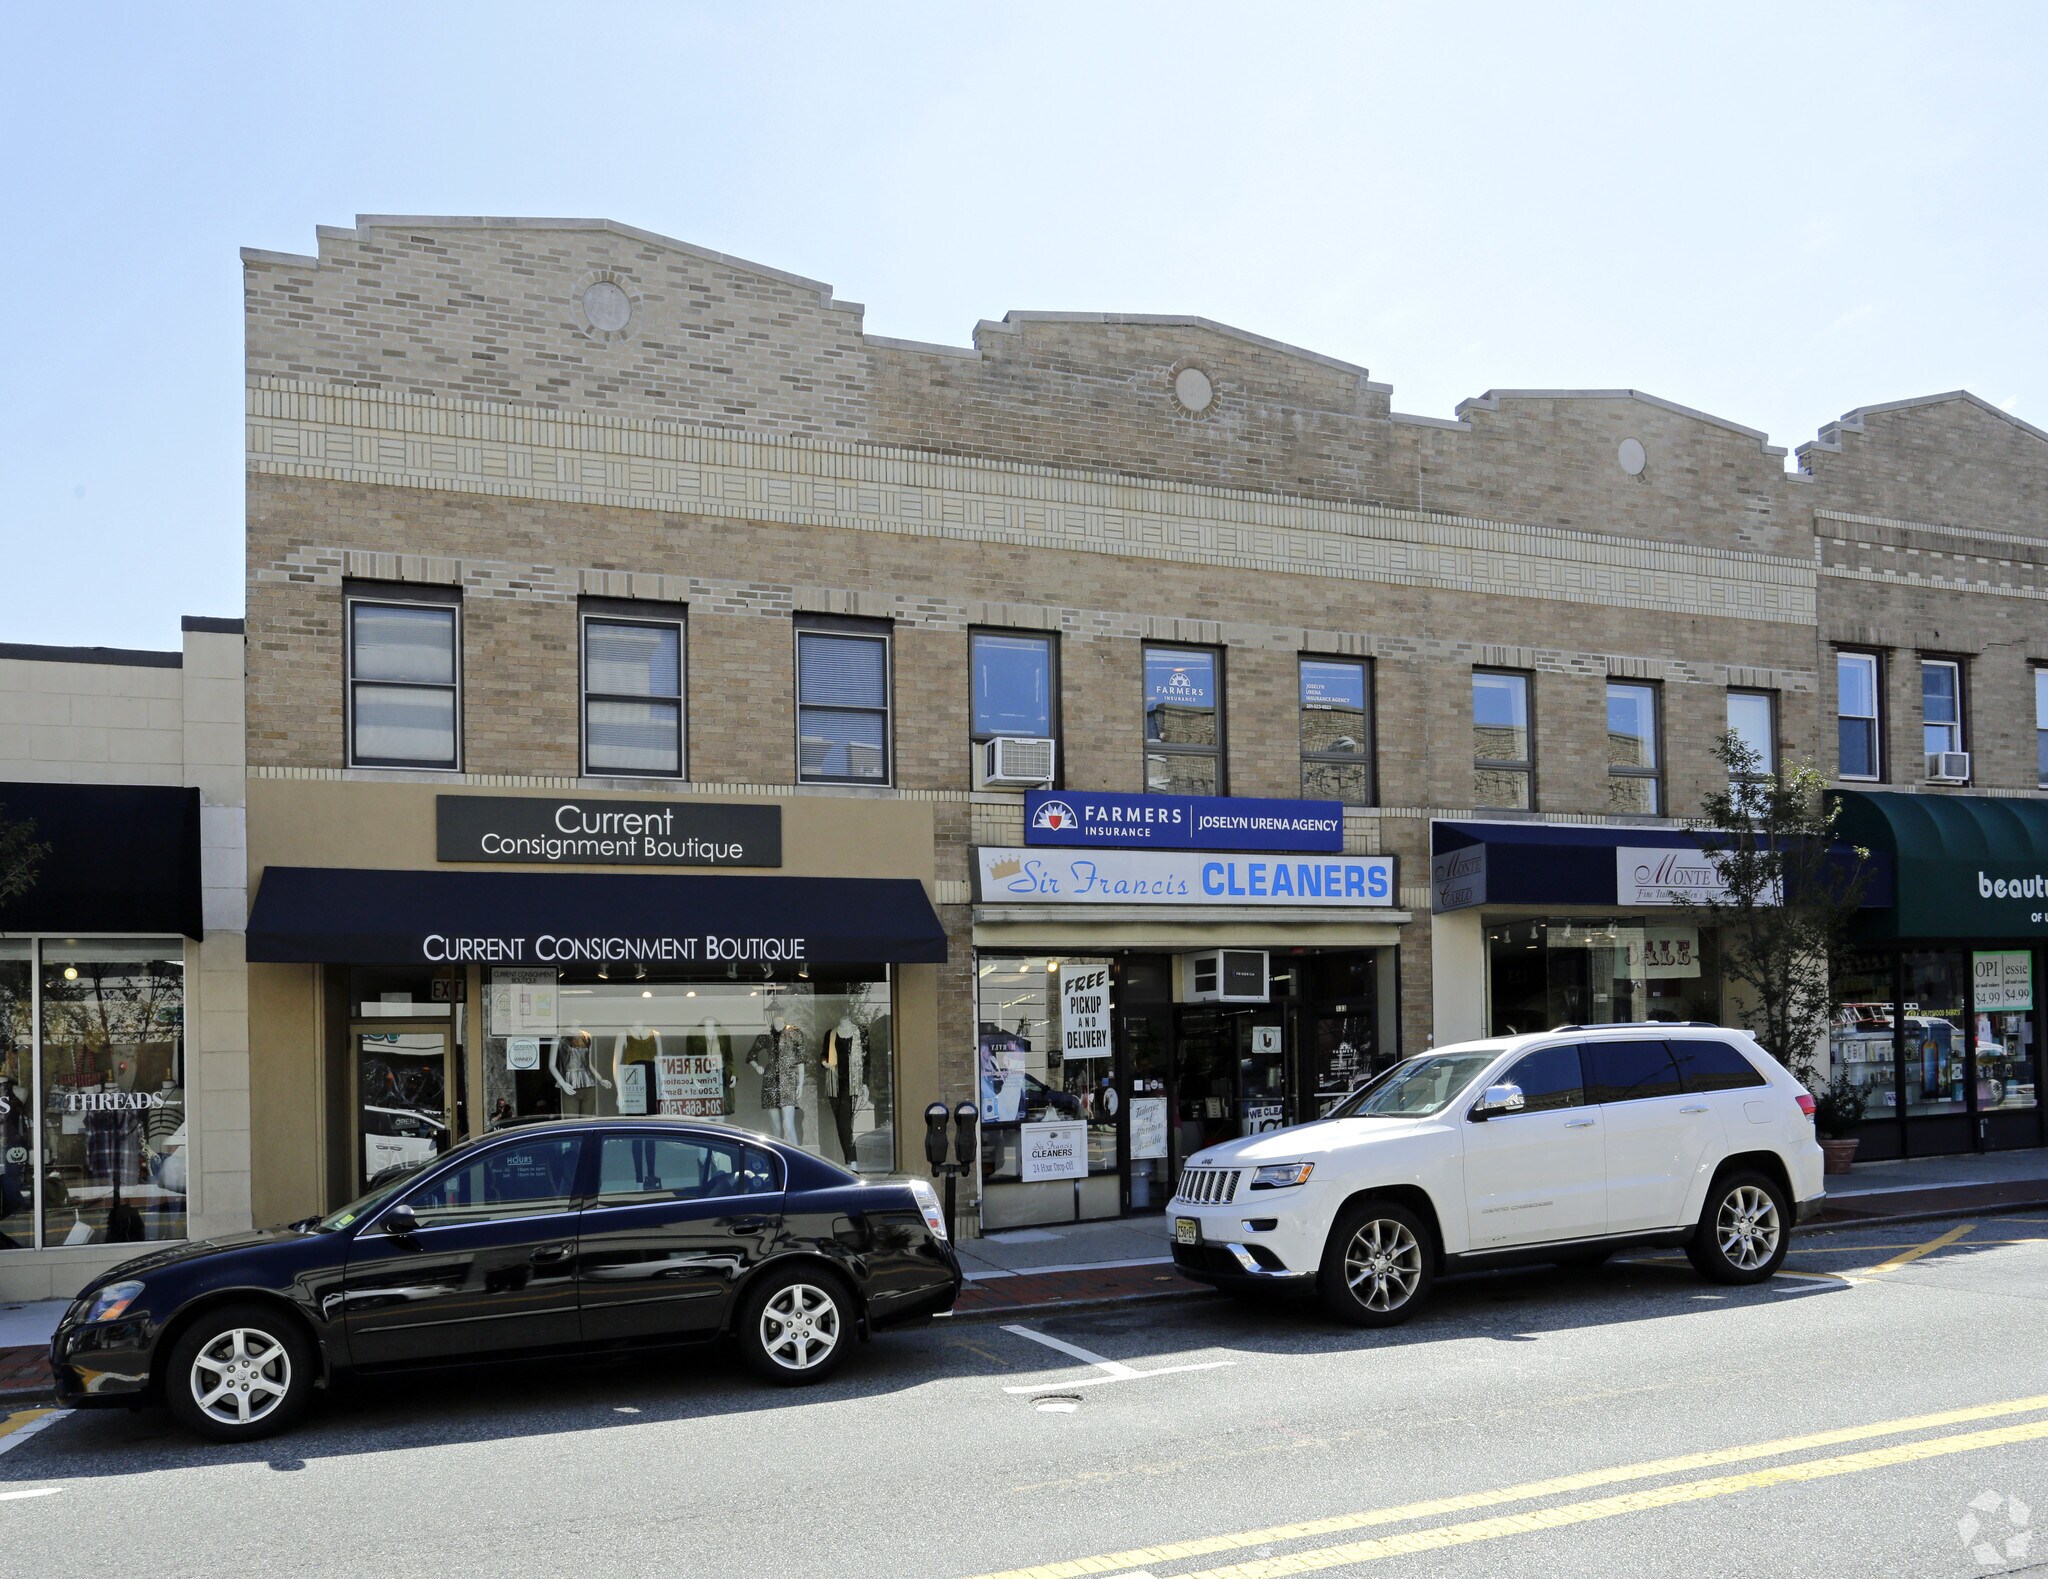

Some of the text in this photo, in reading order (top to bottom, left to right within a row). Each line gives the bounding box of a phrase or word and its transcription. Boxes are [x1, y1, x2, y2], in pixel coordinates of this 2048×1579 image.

[1156, 686, 1204, 696] FARMERS
[555, 804, 673, 836] Current
[1085, 806, 1182, 824] FARMERS
[1198, 815, 1338, 833] JOSELYN URENA AGENCY
[1085, 827, 1151, 838] INSURANCE
[481, 833, 743, 862] Consignment Boutique
[1007, 859, 1388, 898] Sir Francis CLEANERS
[1978, 871, 2048, 899] beaut
[2031, 912, 2042, 923] OF
[1625, 940, 1691, 966] SALE
[1975, 961, 1998, 977] OPI
[2005, 961, 2028, 975] essie
[433, 981, 463, 998] EXT
[1064, 970, 1105, 996] FREE
[1975, 992, 2000, 1005] $4.99
[2005, 989, 2029, 1001] $4.99
[1070, 996, 1102, 1014] PICKUP
[1078, 1017, 1096, 1028] AND
[1067, 1030, 1107, 1049] DELIVERY
[65, 1091, 163, 1112] THREADS
[395, 1118, 416, 1126] OPEN
[1250, 1109, 1262, 1119] WE
[507, 1156, 532, 1165] HOURS
[1032, 1148, 1073, 1159] CLEANERS
